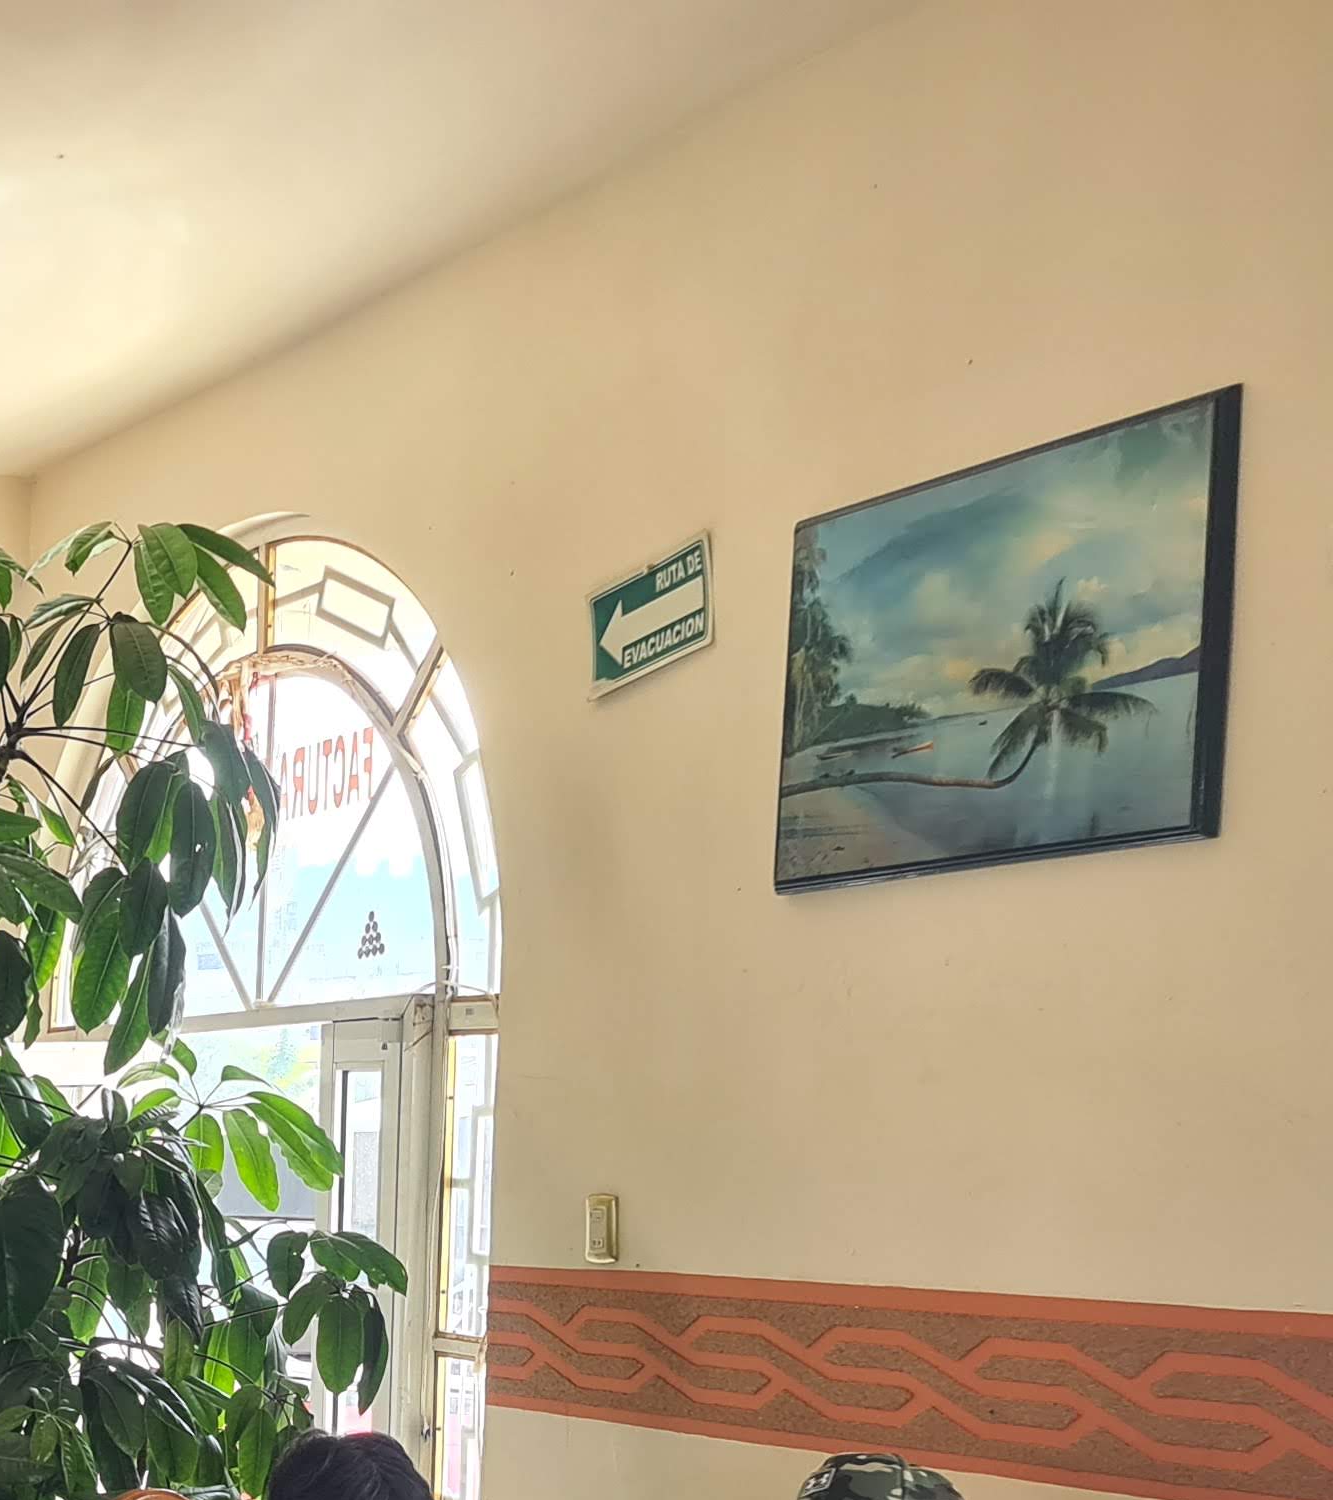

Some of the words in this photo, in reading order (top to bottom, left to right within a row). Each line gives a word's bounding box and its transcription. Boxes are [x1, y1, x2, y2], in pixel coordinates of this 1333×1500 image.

[655, 561, 686, 592] RUTA
[687, 550, 703, 575] DE
[623, 613, 705, 669] EVACUACION
